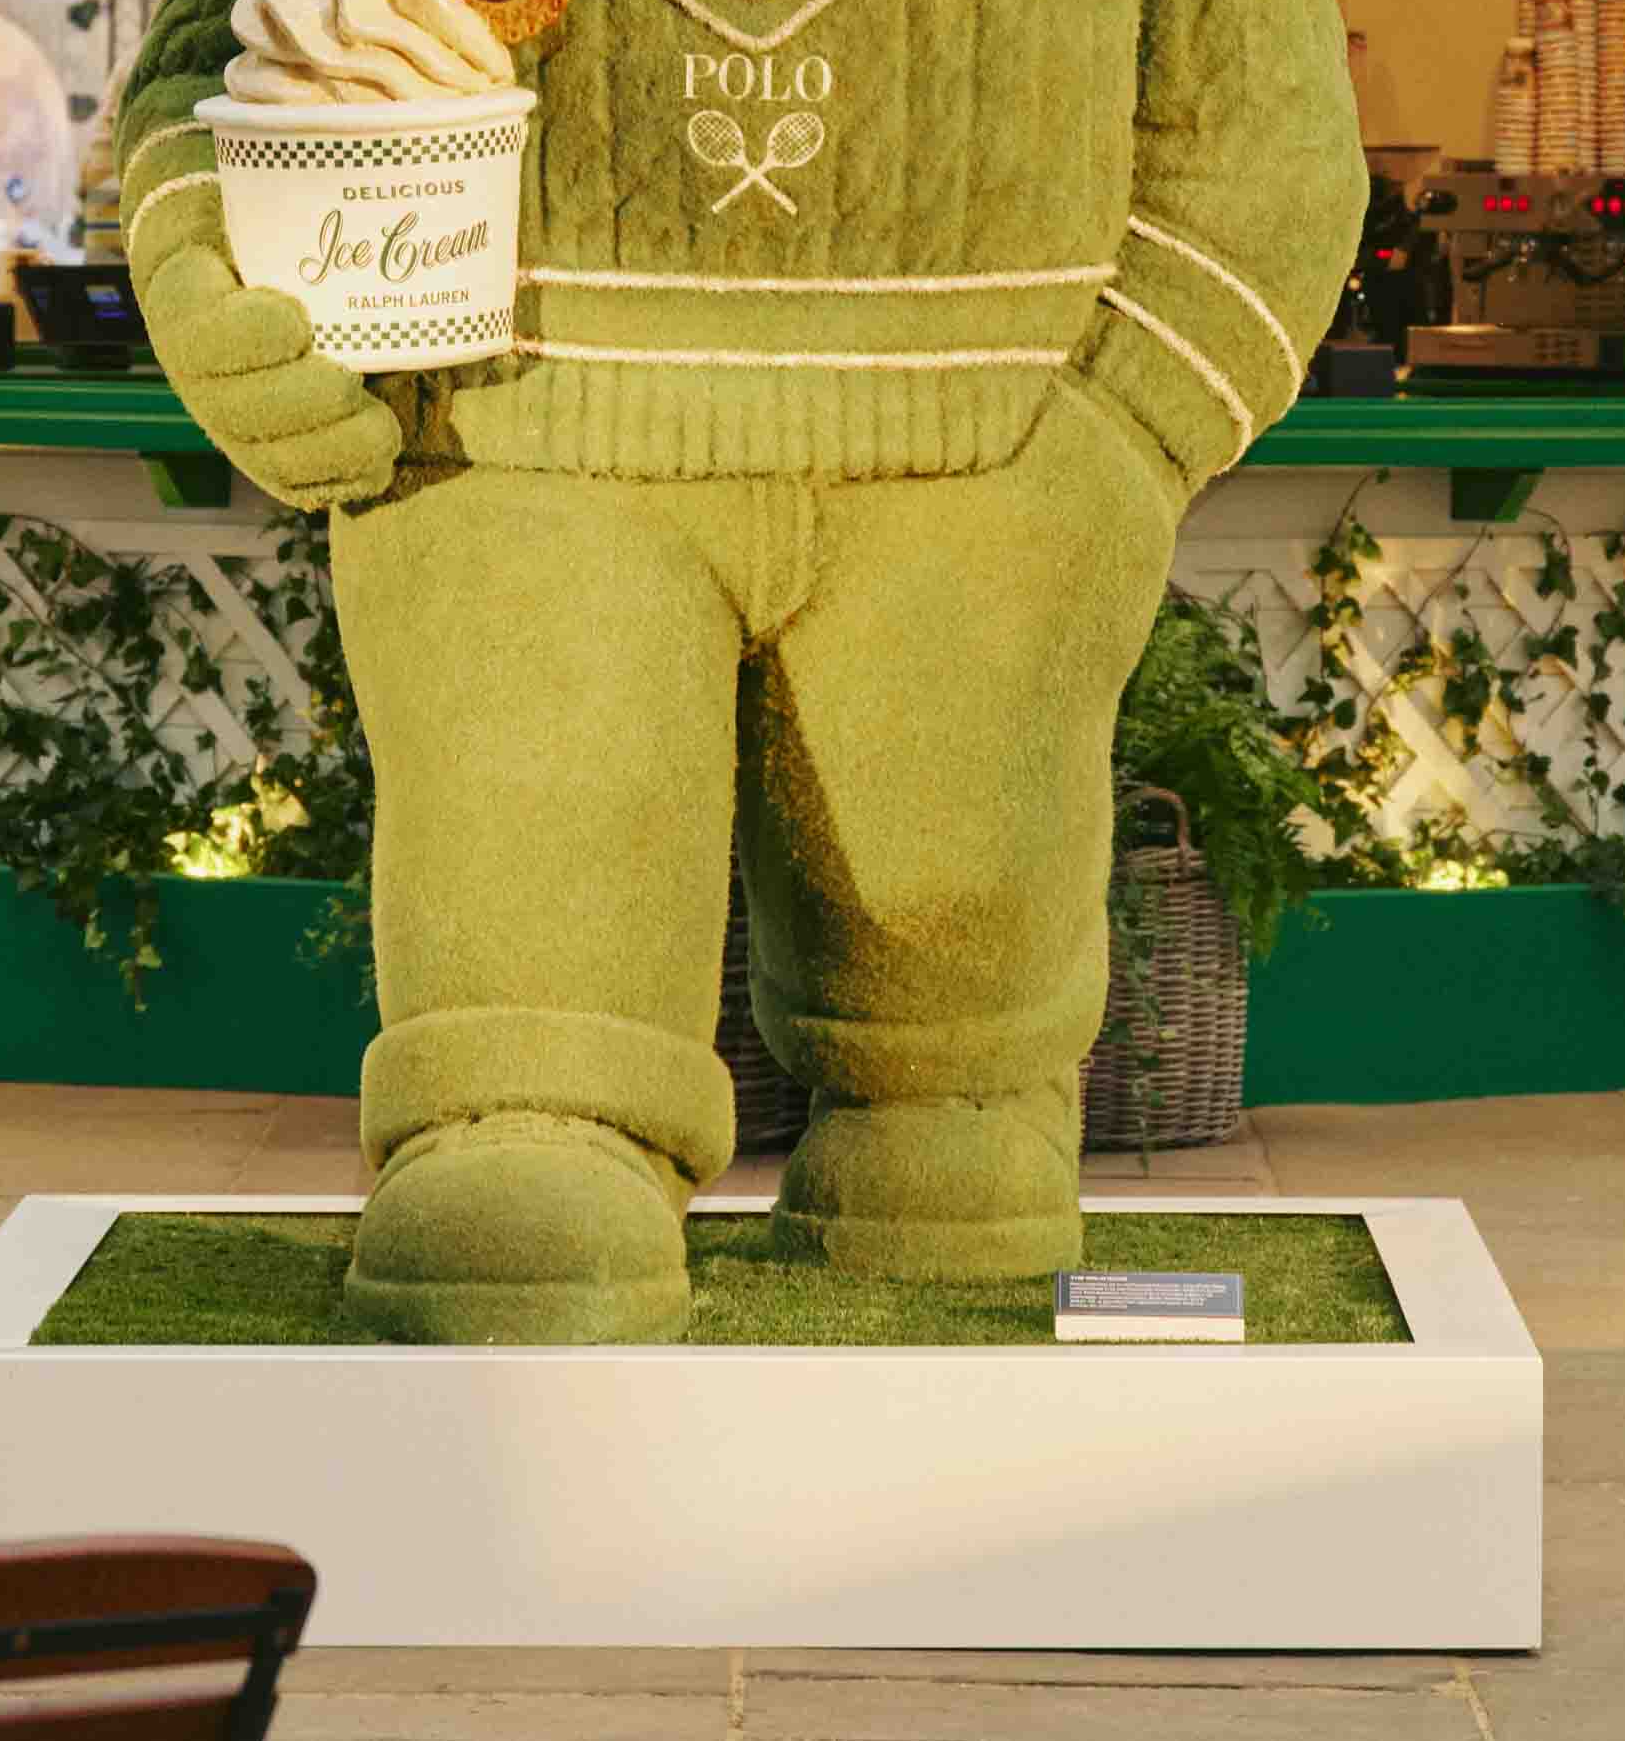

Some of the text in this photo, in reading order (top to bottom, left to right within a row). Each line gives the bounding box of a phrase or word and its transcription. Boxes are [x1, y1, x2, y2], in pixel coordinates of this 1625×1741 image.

[683, 53, 833, 102] POLO
[343, 180, 465, 202] DELICIOUS
[298, 209, 488, 286] Ice Cream
[348, 290, 471, 310] RALPH LAUREN
